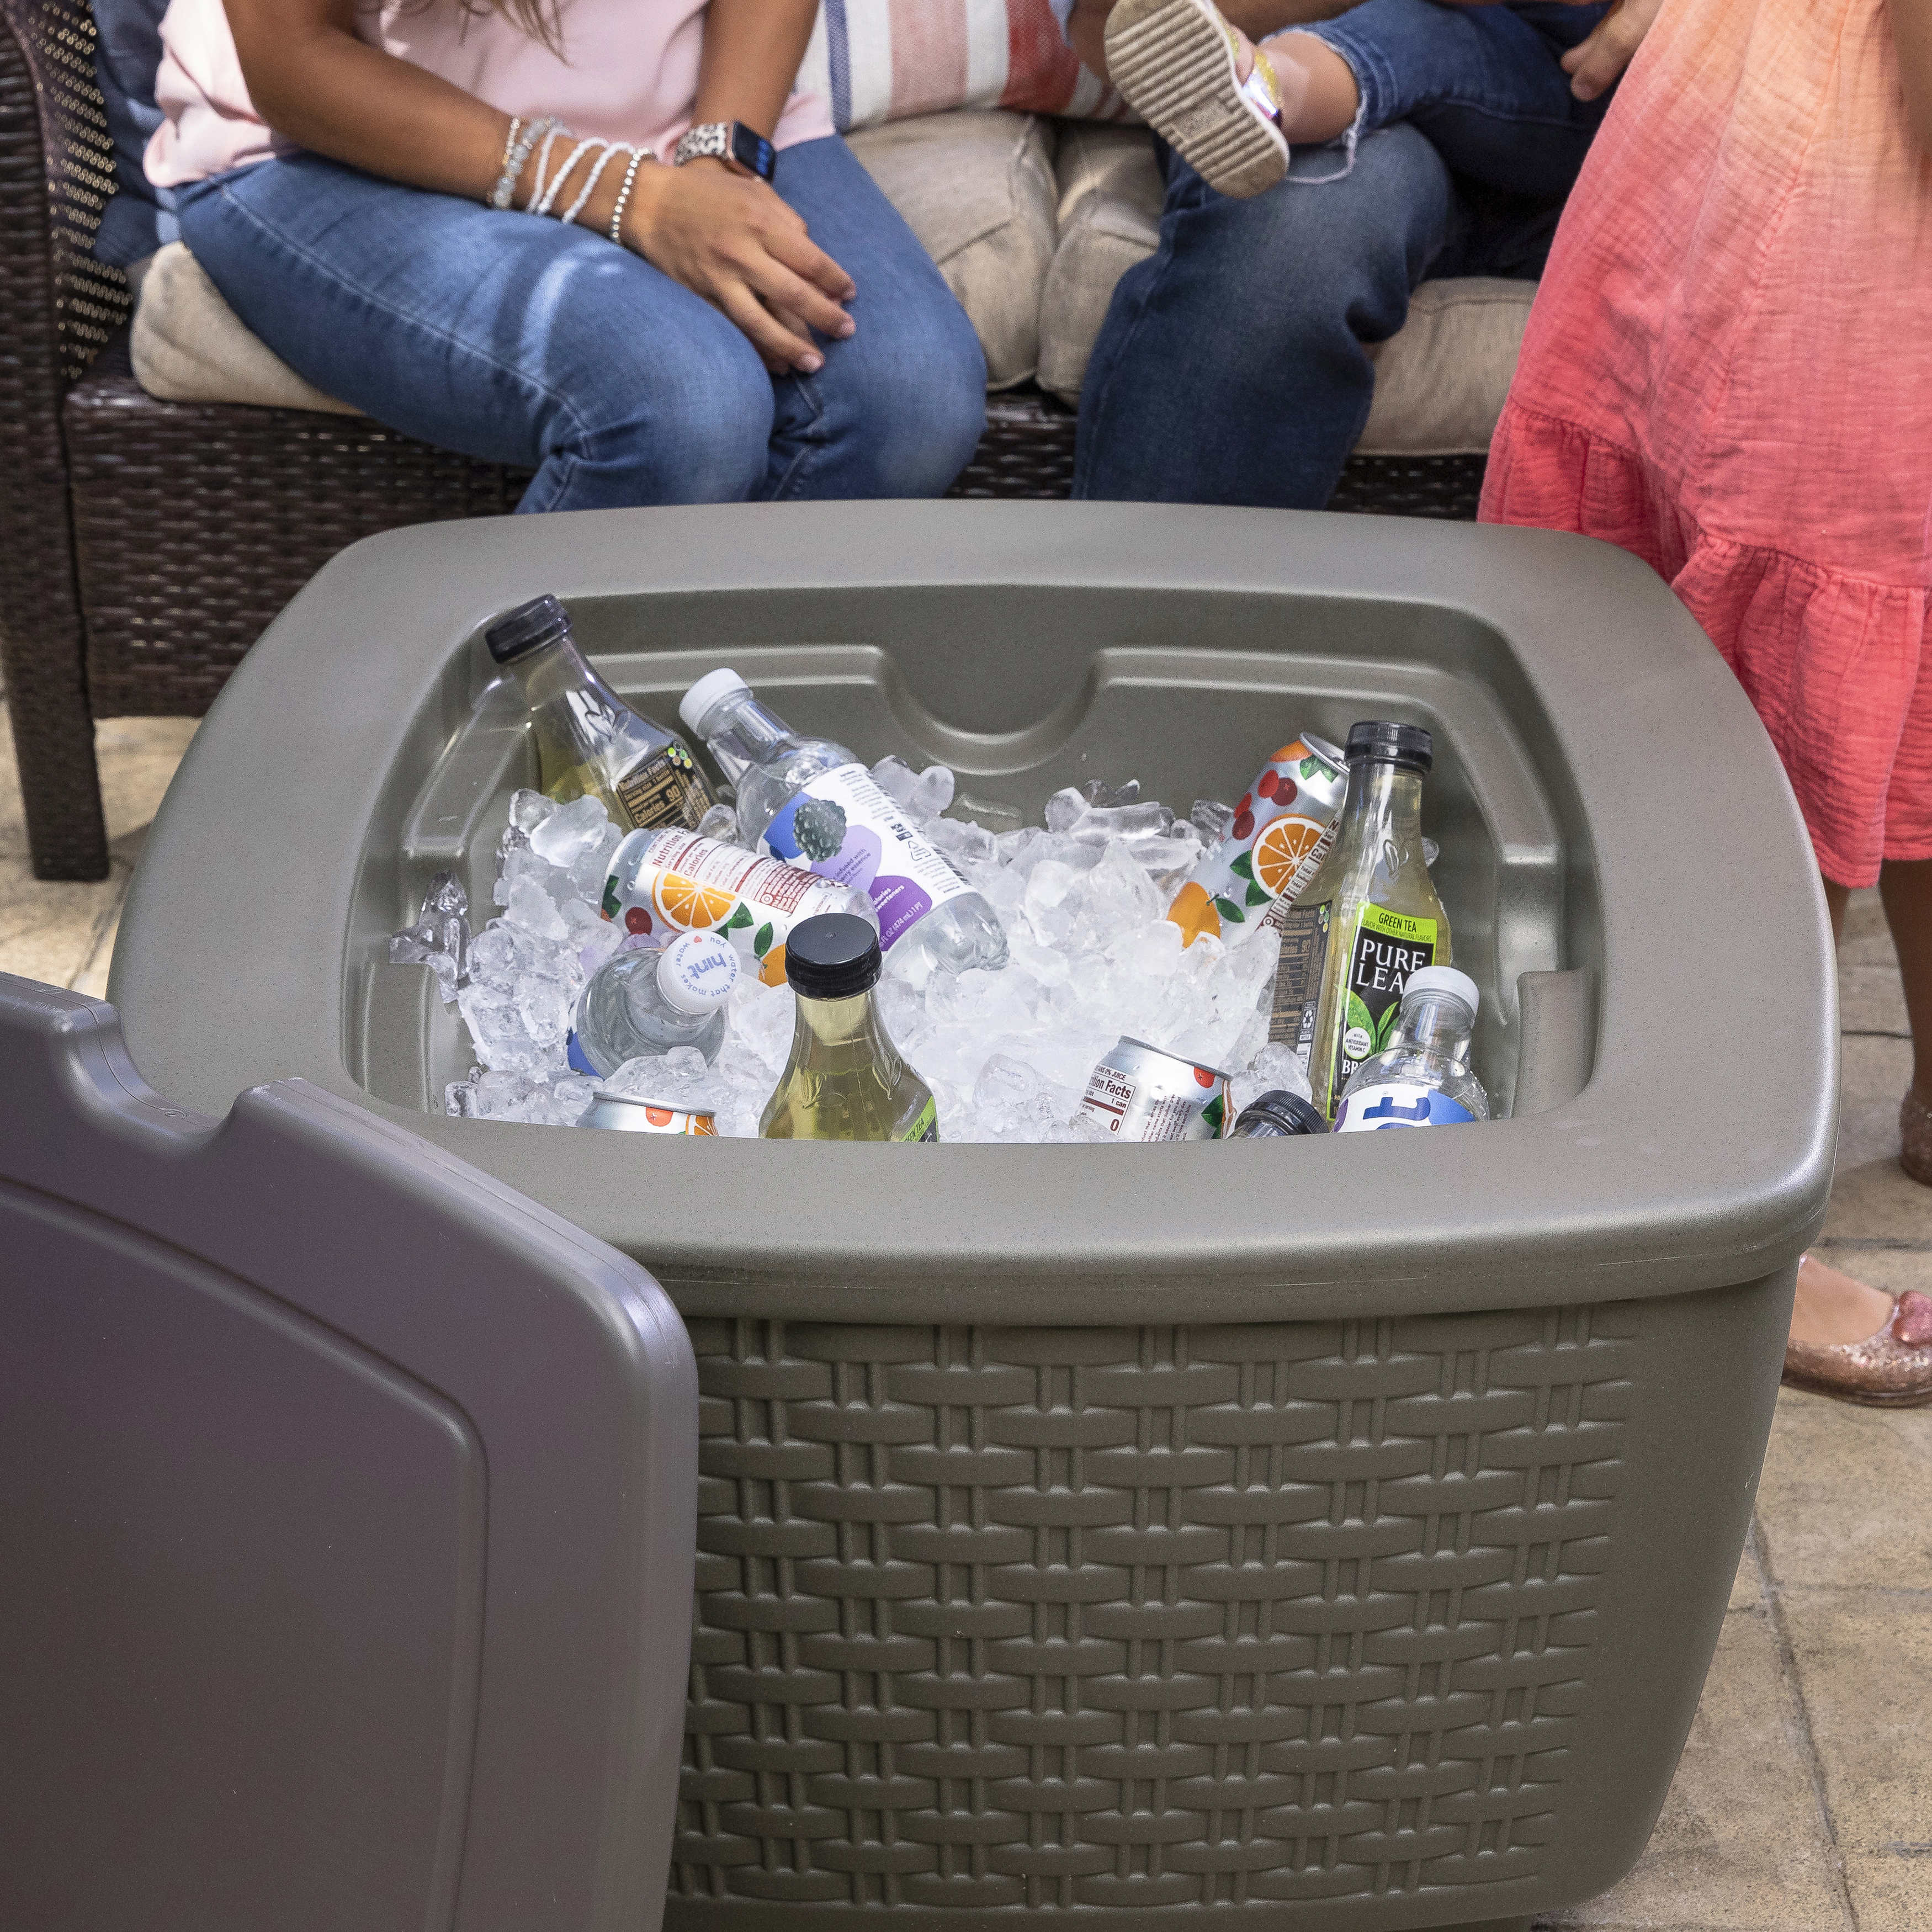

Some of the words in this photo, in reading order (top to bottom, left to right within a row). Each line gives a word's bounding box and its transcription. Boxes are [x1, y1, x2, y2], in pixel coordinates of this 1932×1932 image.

[635, 801, 665, 821] Calories
[665, 784, 681, 802] 90
[652, 834, 682, 866] Nutrition
[684, 848, 708, 876] Calories
[872, 887, 891, 905] alories
[1379, 912, 1403, 930] GREEN
[1404, 920, 1416, 933] TEA
[710, 937, 726, 948] you
[676, 942, 690, 967] water
[1360, 938, 1425, 972] PURE
[729, 953, 737, 983] water
[681, 974, 707, 996] makes
[1356, 963, 1405, 994] LEA
[710, 984, 731, 997] that
[1345, 1038, 1369, 1047] ANTIOXIDANT
[1111, 1071, 1127, 1081] JUICE
[1105, 1080, 1132, 1099] Facts
[1116, 1100, 1127, 1108] can
[916, 1117, 925, 1133] TEA
[1110, 1119, 1119, 1132] 0
